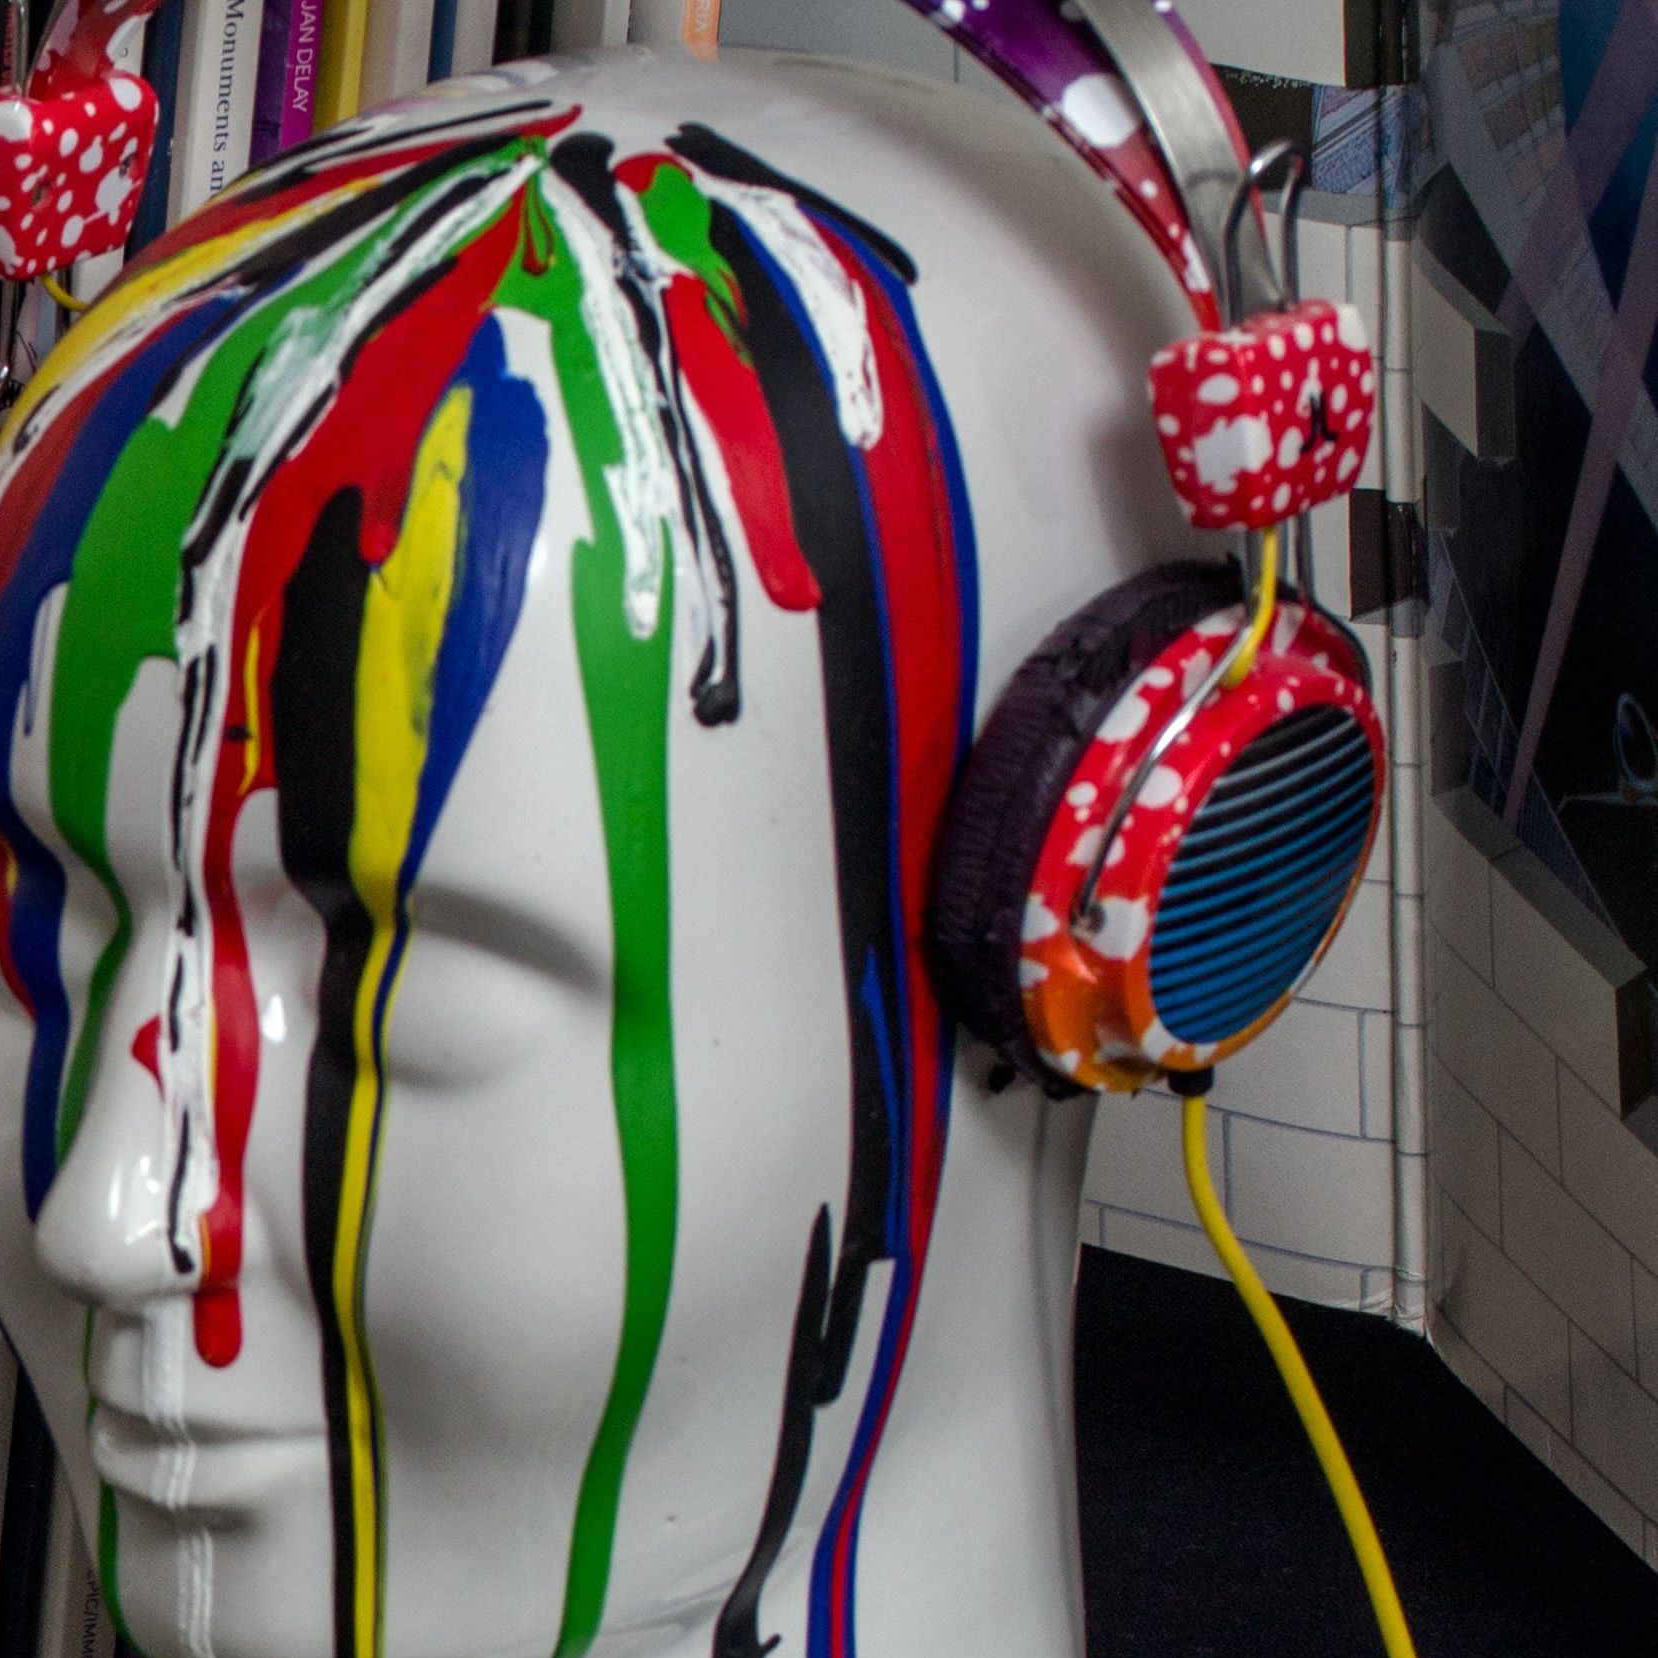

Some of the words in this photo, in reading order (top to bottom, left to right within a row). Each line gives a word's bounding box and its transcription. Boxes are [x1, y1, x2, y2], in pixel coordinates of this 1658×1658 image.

[298, 0, 317, 43] JAN
[213, 0, 245, 152] Monuments
[292, 48, 313, 113] DELAY
[209, 160, 225, 192] an
